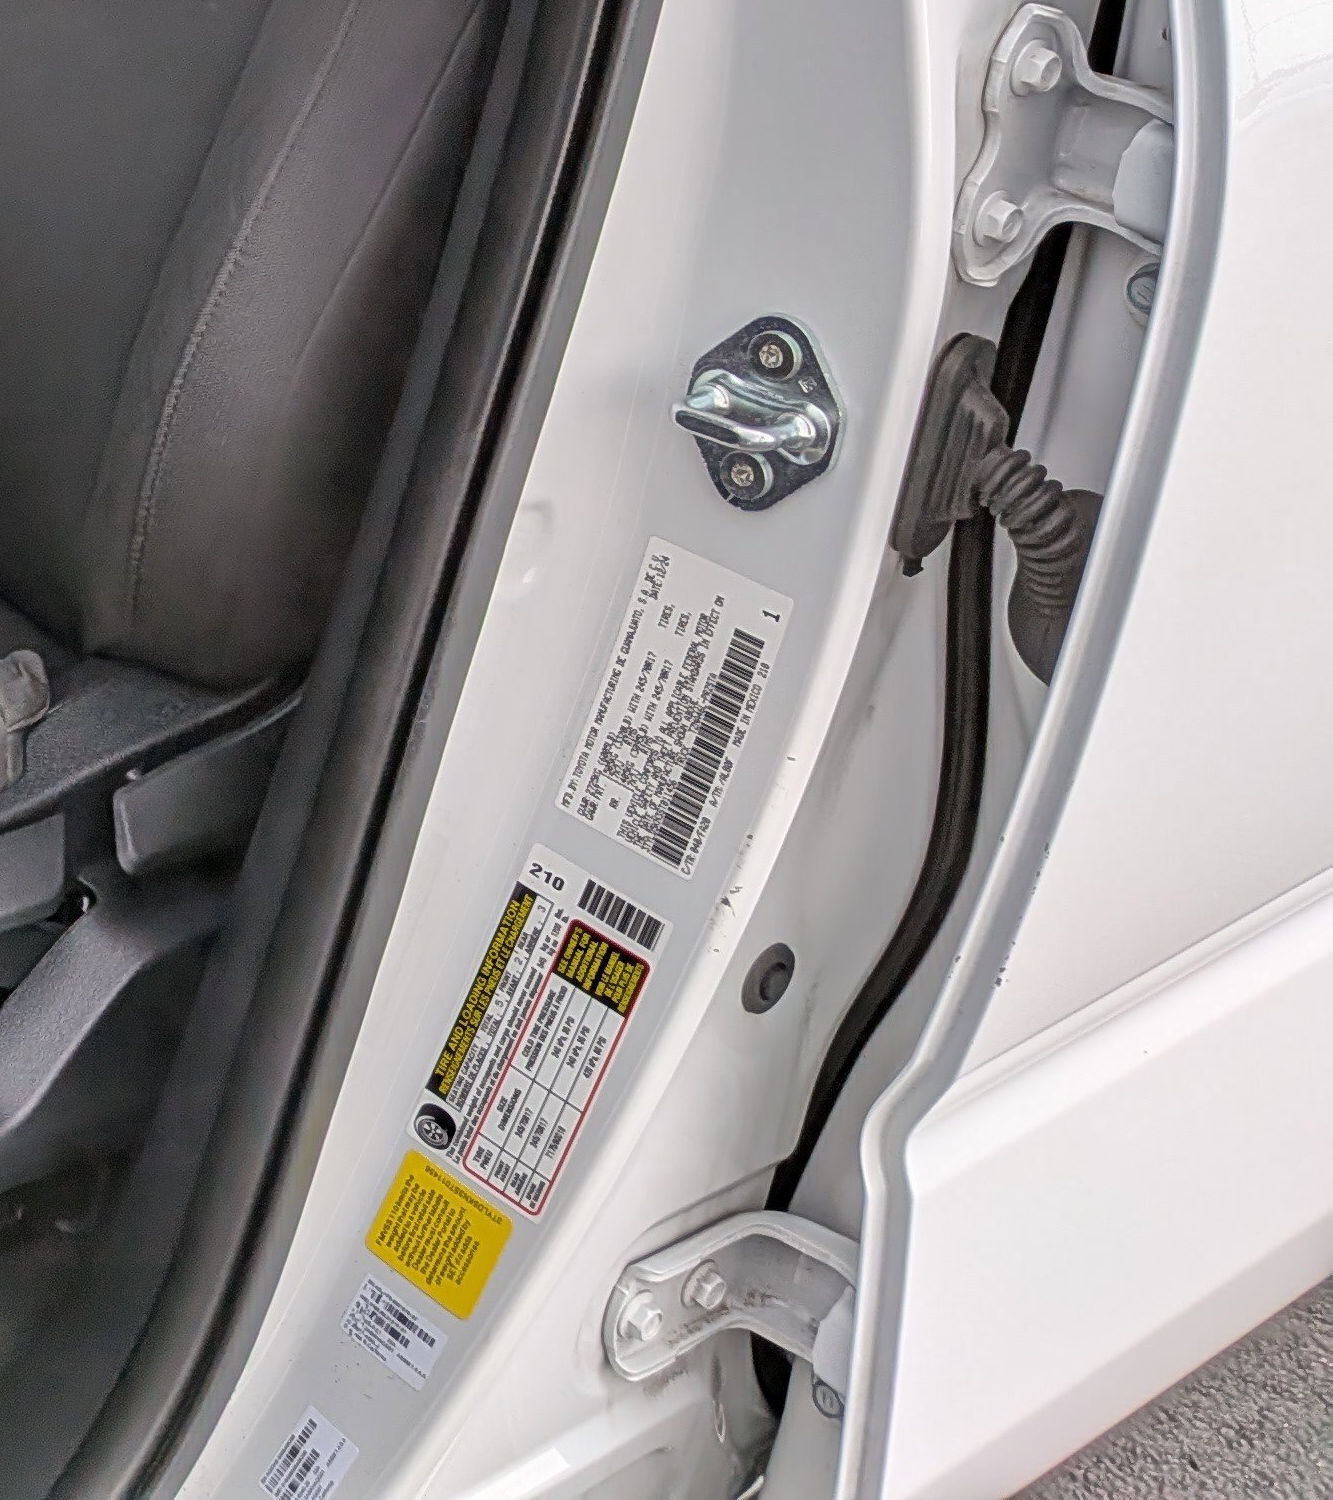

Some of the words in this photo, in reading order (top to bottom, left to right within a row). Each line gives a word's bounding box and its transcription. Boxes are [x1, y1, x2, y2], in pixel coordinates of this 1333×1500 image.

[761, 607, 780, 622] 1
[626, 691, 641, 713] WITH
[643, 700, 657, 722] WITH
[731, 726, 746, 748] MADE
[743, 682, 762, 713] MEXICO
[756, 661, 770, 679] 210
[572, 749, 589, 779] TOYOTA
[584, 725, 599, 750] MOTOR
[593, 667, 621, 726] MANUFACTURING
[528, 861, 565, 892] 210
[504, 893, 535, 948] CHARGEMENT
[512, 955, 523, 965] 2
[536, 903, 547, 913] 3
[495, 956, 506, 969] ET
[499, 946, 511, 958] LE
[434, 1049, 453, 1078] TIRE
[446, 1024, 465, 1052] AND
[457, 974, 487, 1027] LOADING
[479, 899, 521, 977] INFORMATION
[483, 967, 501, 995] PNEUS
[476, 993, 490, 1010] LES
[468, 1008, 483, 1027] SUR
[438, 1024, 475, 1095] RENSEIGNEMENTS
[496, 1095, 508, 1112] SIZE
[497, 1086, 522, 1132] DIMENSIONS
[472, 1145, 485, 1163] TIRE
